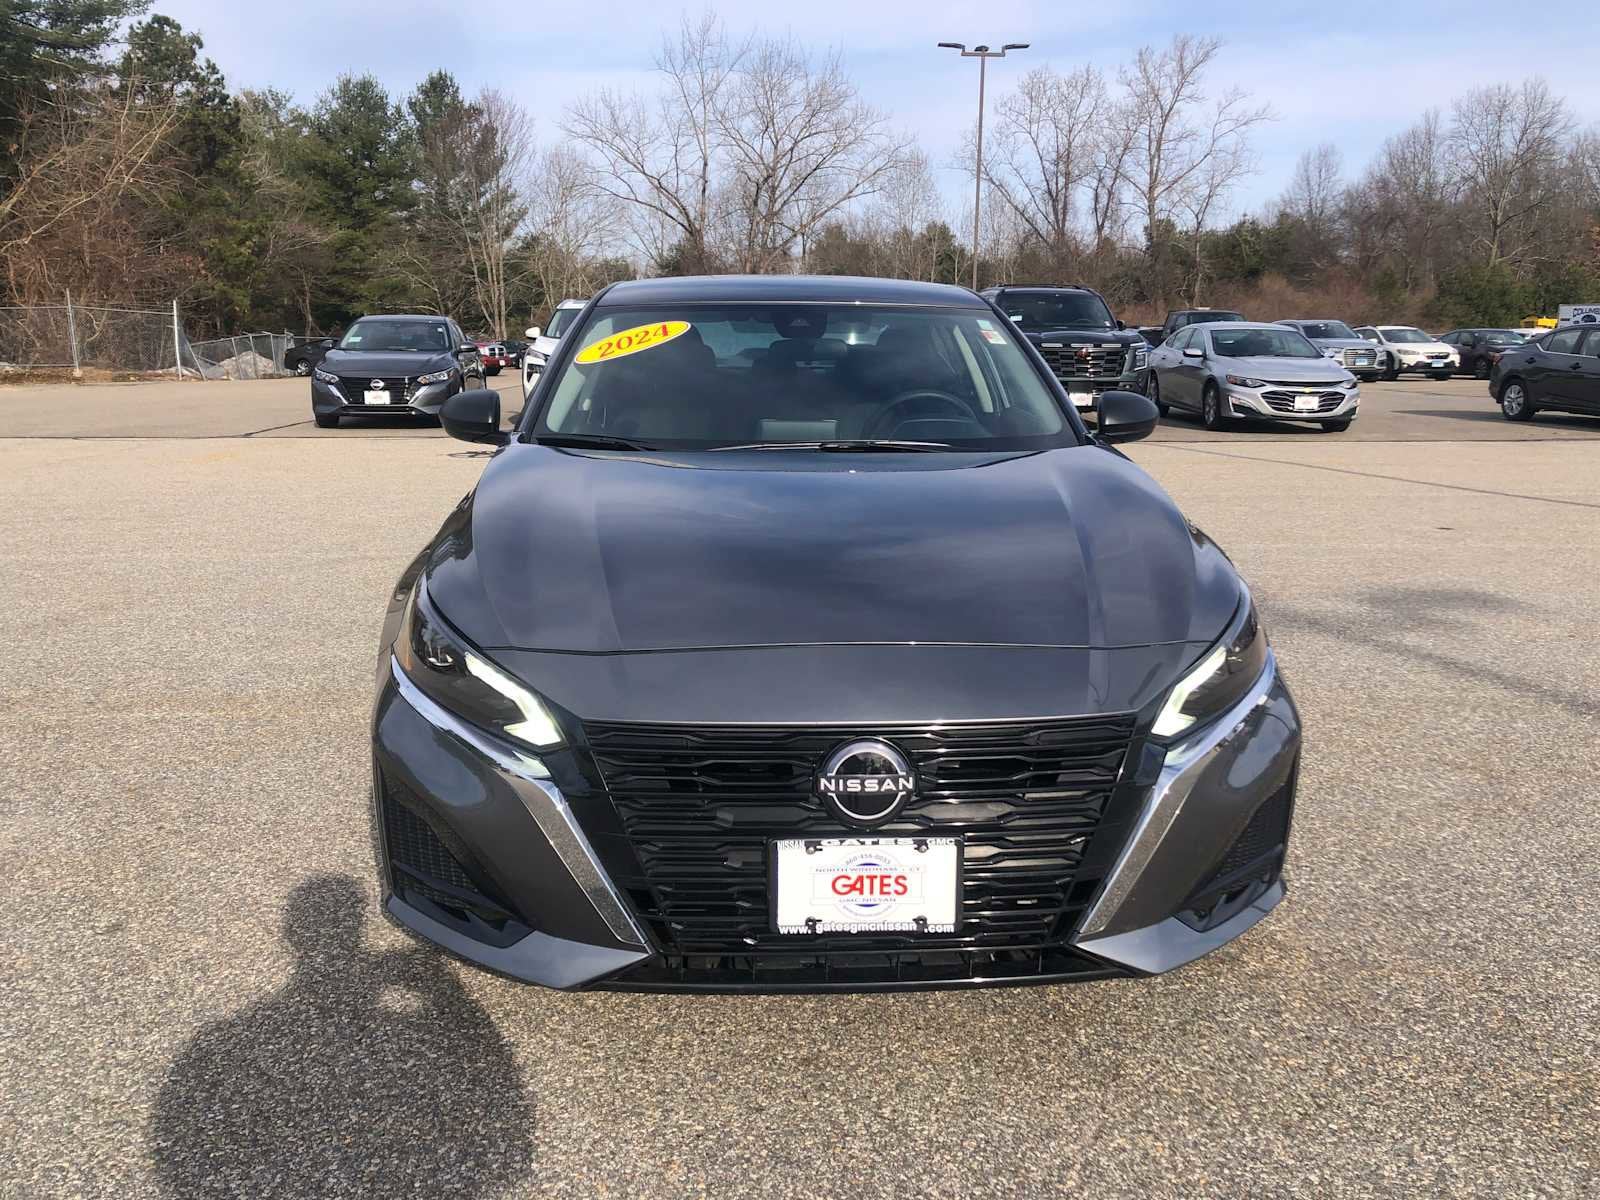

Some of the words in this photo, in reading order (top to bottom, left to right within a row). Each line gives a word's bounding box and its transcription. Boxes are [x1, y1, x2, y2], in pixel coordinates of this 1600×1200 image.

[598, 324, 669, 358] 2024
[820, 776, 913, 792] NISSAN
[831, 874, 908, 896] GATES
